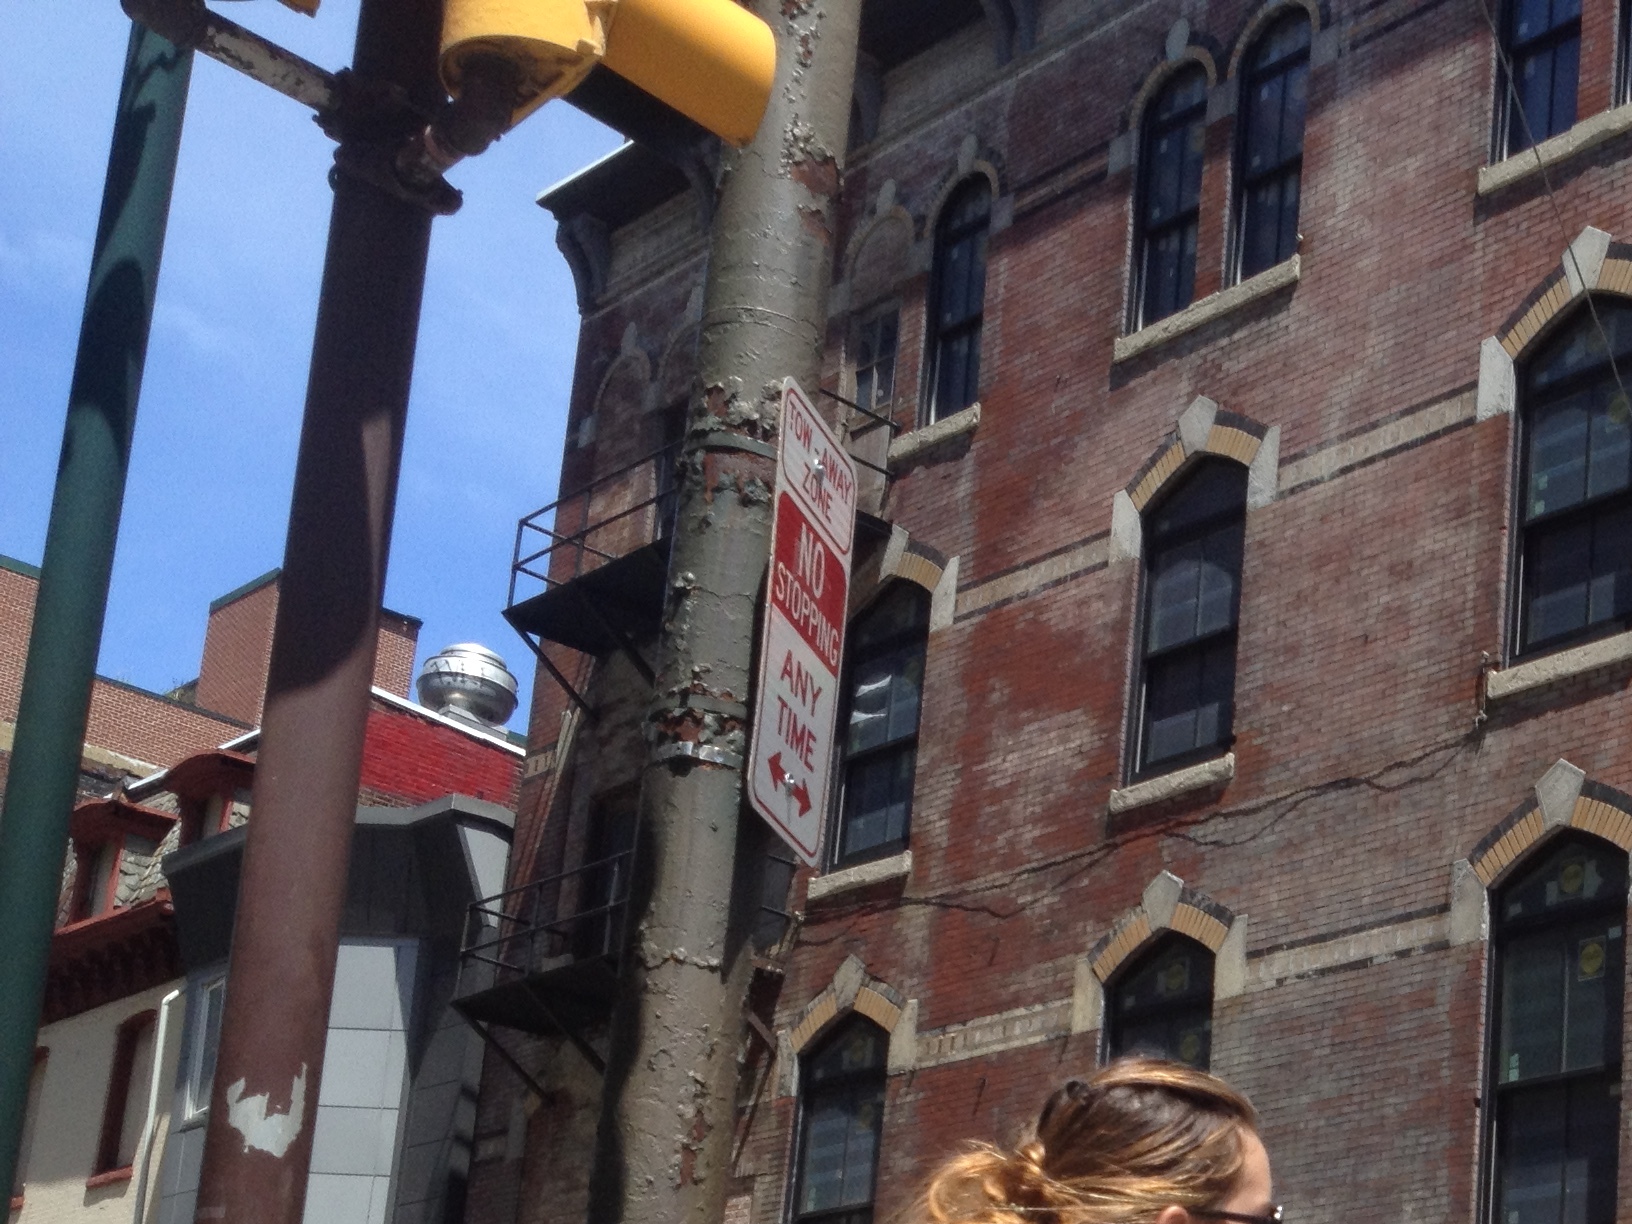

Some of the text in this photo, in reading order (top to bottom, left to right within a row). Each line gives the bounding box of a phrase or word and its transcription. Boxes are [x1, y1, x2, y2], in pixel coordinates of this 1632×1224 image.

[802, 474, 834, 522] ZONE
[799, 521, 826, 599] NO
[775, 560, 840, 668] STOPPING
[780, 649, 822, 717] ANY
[777, 697, 816, 773] TIME
